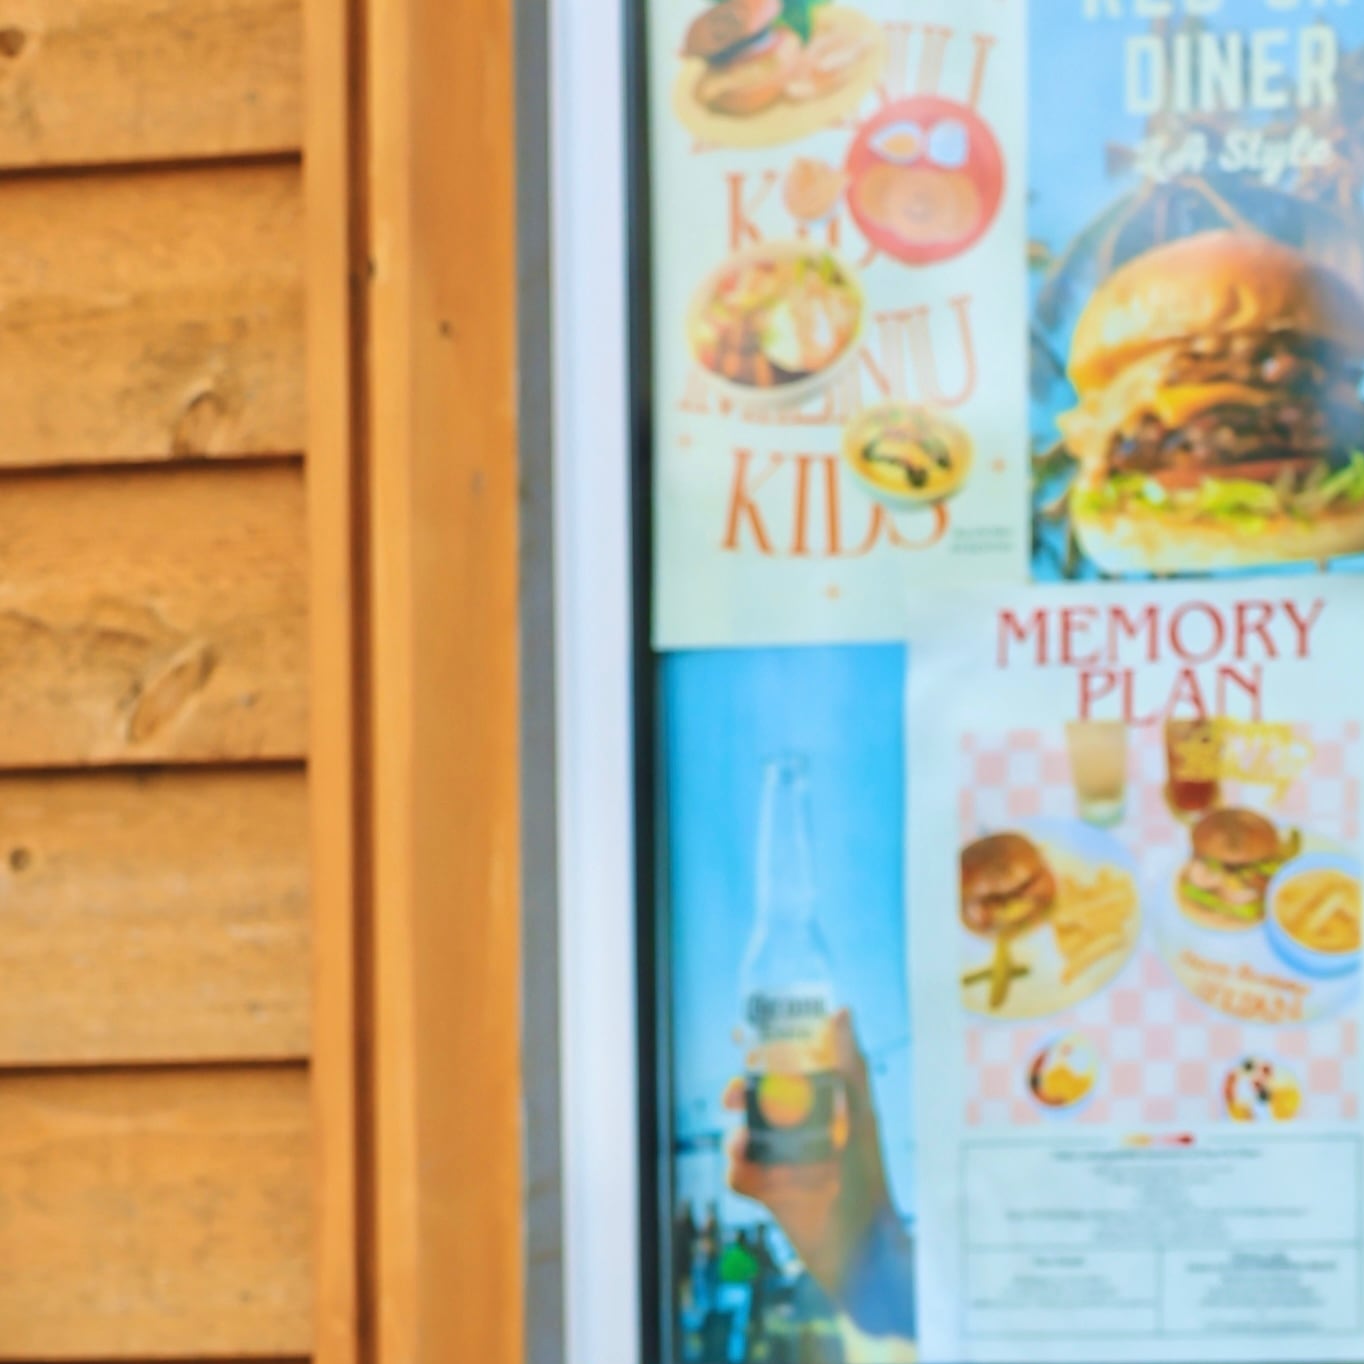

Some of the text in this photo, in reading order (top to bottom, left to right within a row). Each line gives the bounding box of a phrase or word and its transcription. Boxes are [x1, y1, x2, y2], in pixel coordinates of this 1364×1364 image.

[1124, 24, 1338, 115] DINER
[1219, 125, 1334, 185] Style
[996, 597, 1325, 668] MEMORY
[1078, 663, 1264, 727] PLAN
